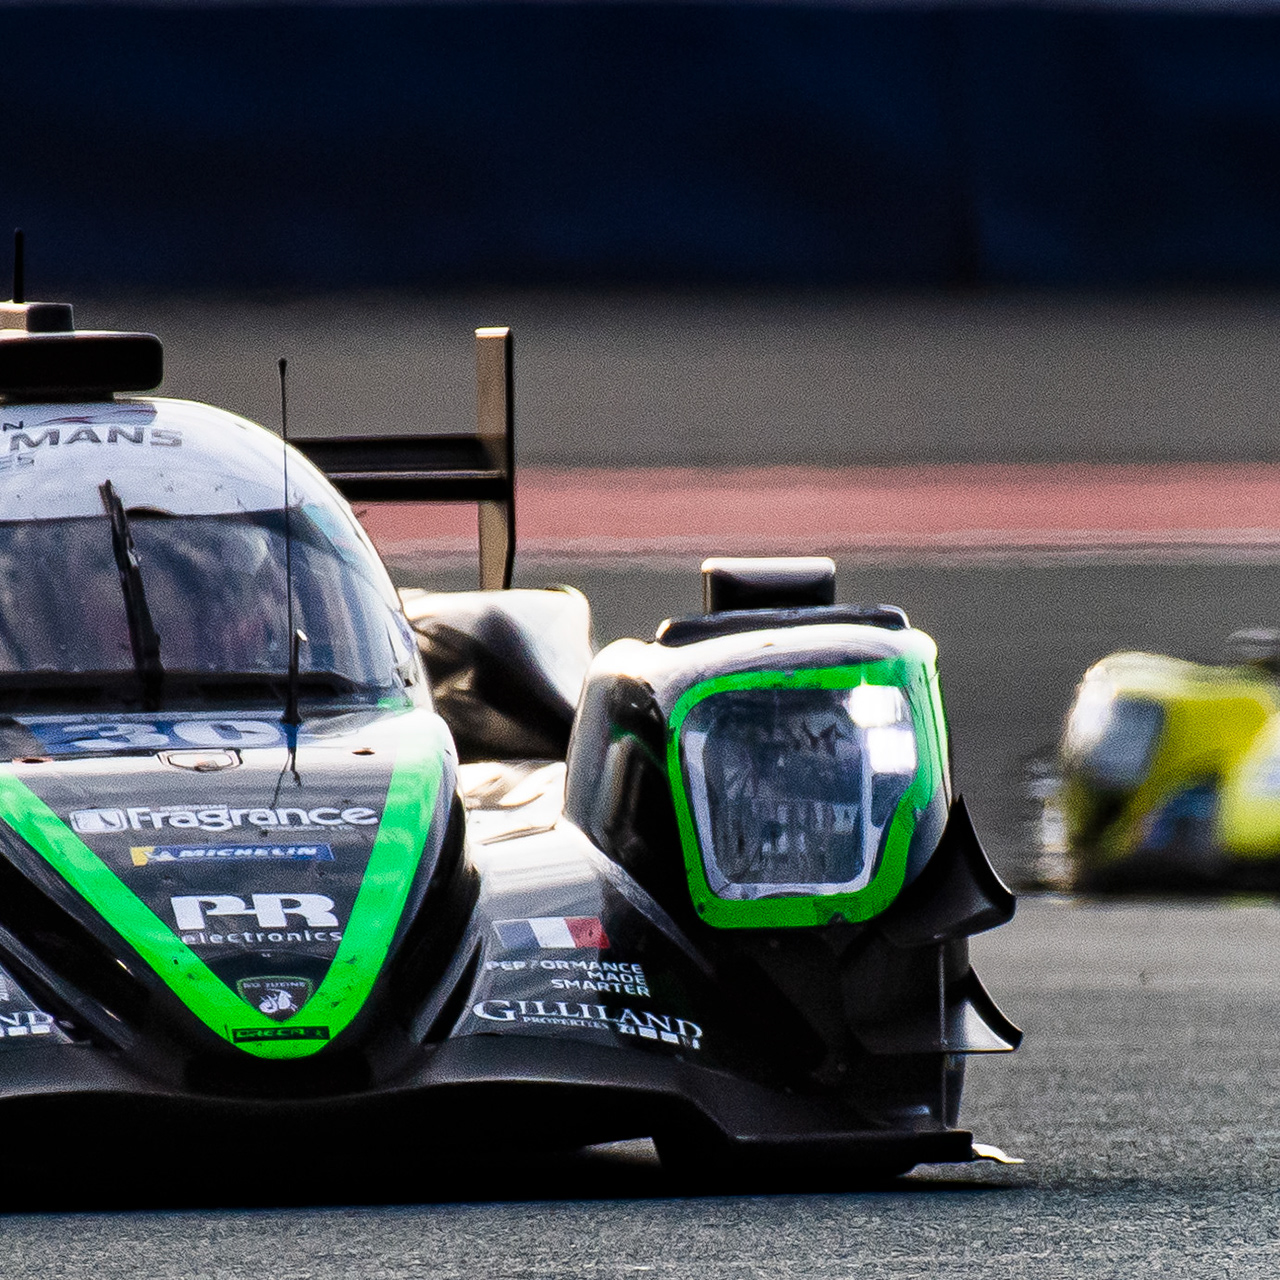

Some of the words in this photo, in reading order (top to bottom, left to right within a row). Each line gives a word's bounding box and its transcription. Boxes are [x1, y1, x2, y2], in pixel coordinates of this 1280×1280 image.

[10, 426, 180, 451] MANS
[63, 721, 281, 749] 30
[126, 806, 379, 831] Fragrance
[178, 847, 318, 859] MICHELIN
[171, 893, 340, 930] PR
[182, 931, 343, 945] electronics
[551, 979, 651, 997] SMARTER
[587, 971, 646, 985] MADE
[472, 1000, 703, 1039] GILLILAND
